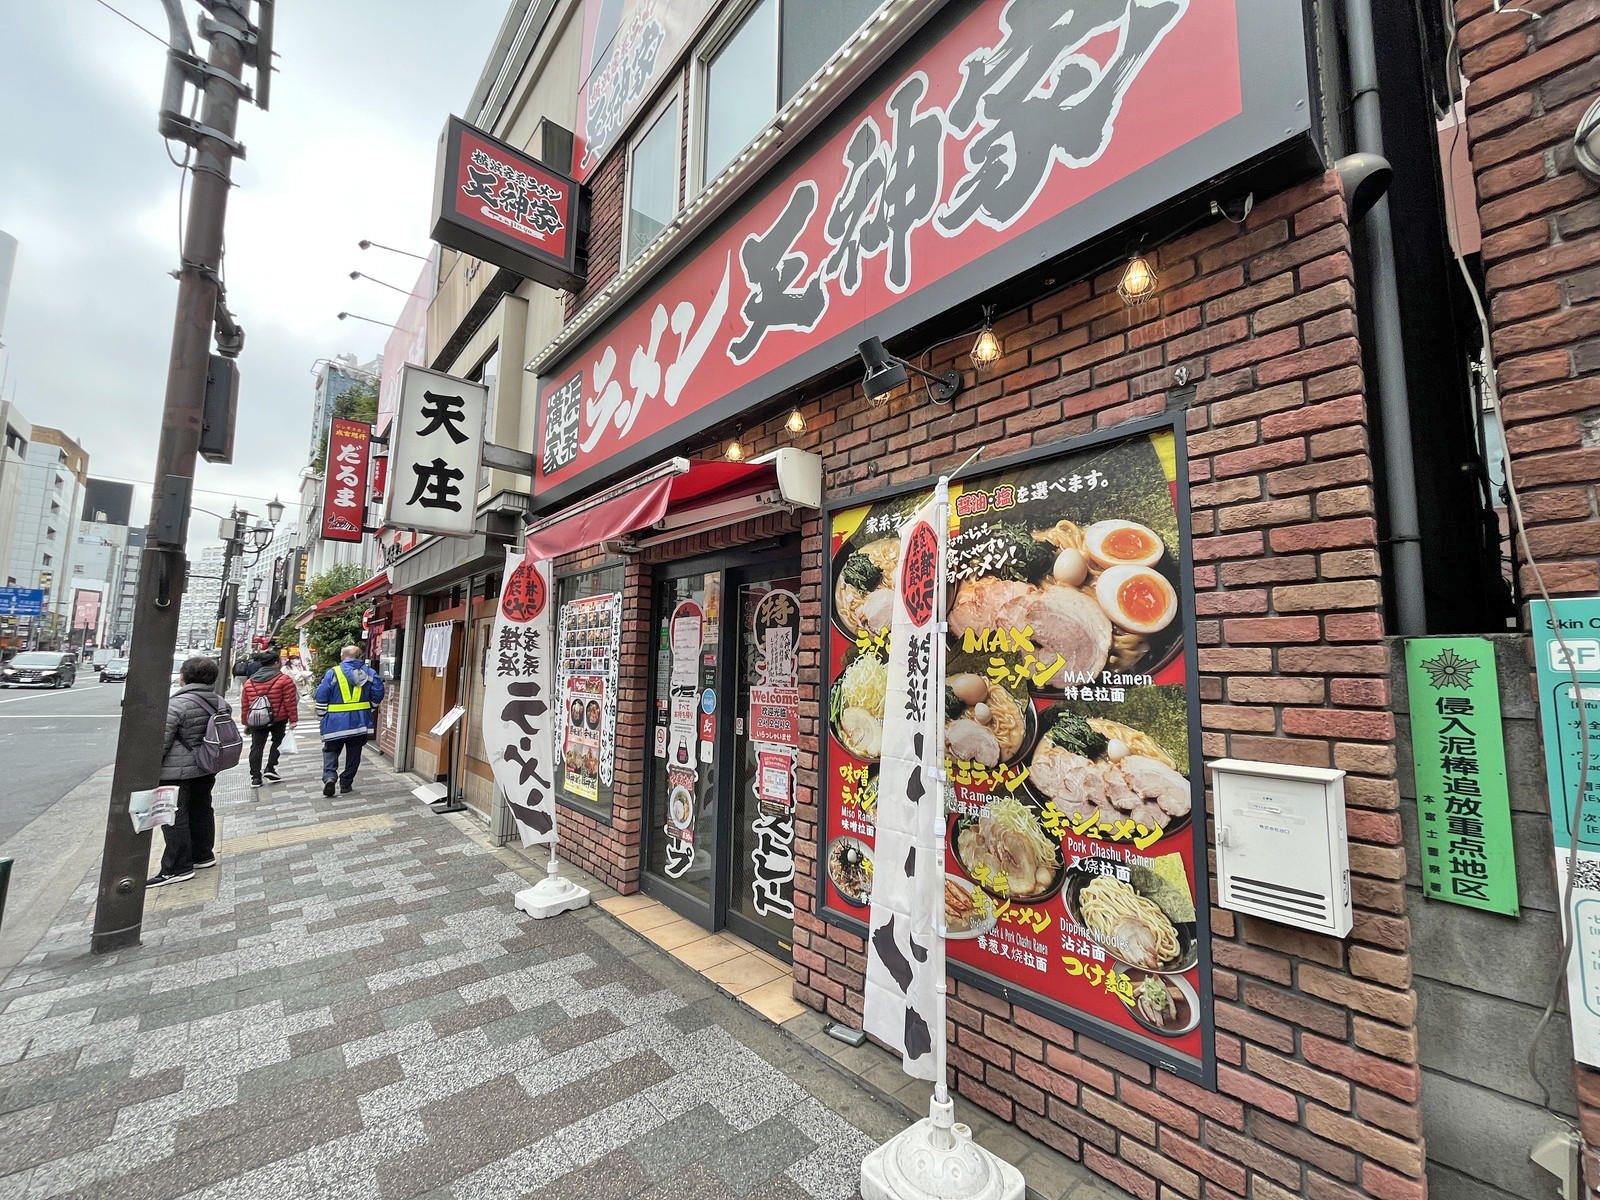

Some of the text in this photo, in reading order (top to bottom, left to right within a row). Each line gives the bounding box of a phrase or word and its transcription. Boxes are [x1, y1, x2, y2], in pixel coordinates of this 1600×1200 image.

[580, 250, 733, 454] ラーメン
[405, 390, 470, 513] 天庄
[333, 443, 363, 508] だるま
[962, 624, 1035, 654] MAX
[1546, 618, 1584, 630] Skin
[986, 651, 1067, 690] ラーメン
[1557, 647, 1596, 665] 2F
[1064, 670, 1153, 686] MAX Ramen
[751, 690, 799, 705] Welcome
[1064, 686, 1126, 703] 特色拉面
[756, 730, 792, 742] いらっしゃいませ
[841, 805, 856, 819] Miso
[960, 787, 1001, 805] Ramen
[1435, 696, 1491, 902] 侵入泥棒追放重点地区
[1041, 801, 1164, 851] チャーシューメン
[1067, 837, 1155, 869] Pork Chashu Ramen
[1422, 794, 1443, 893] 本富士警察署
[970, 861, 1010, 899] ネギ
[1070, 854, 1131, 883] 叉烧拉面
[970, 885, 1052, 935] チャーシューメン
[1060, 917, 1129, 952] Dipping Noodles
[1061, 933, 1106, 963] 沾沾面
[1061, 956, 1136, 1007] つけ麺
